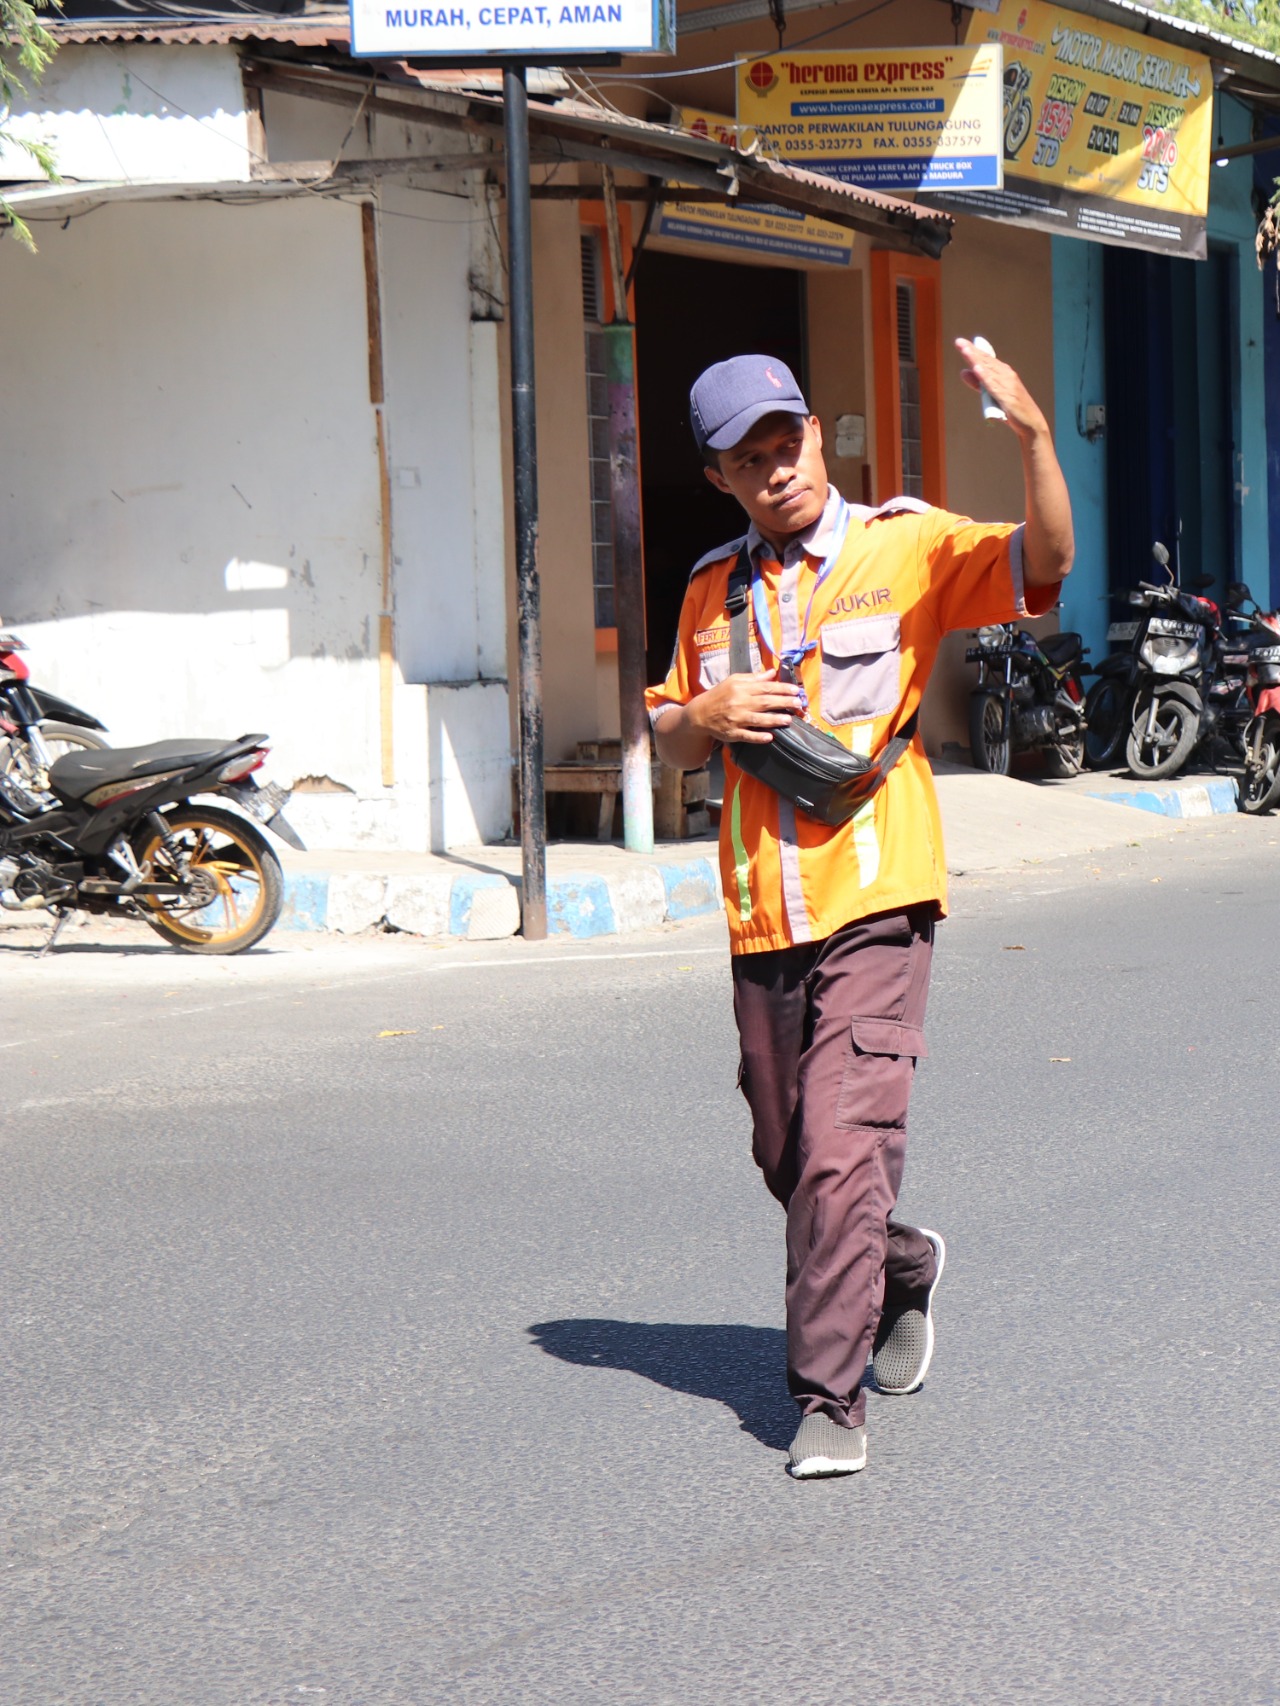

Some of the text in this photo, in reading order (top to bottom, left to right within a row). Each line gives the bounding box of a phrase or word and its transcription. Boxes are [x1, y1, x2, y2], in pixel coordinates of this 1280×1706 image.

[386, 4, 622, 30] MURAH, CEPAT, AMAN
[1051, 22, 1103, 72] MOTOR
[1100, 40, 1142, 84] MASUK
[1139, 53, 1200, 99] SEKOLAH
[1045, 74, 1086, 105] DISKON
[799, 99, 936, 114] www.heronaexpress.co.id
[1143, 102, 1186, 132] DISKON
[755, 119, 982, 135] KANTOR PERWAKILAN TULUNGAGUNG
[1035, 100, 1074, 142] 15%
[785, 137, 863, 150] 0355-323773
[873, 137, 899, 148] FAX.
[1032, 136, 1061, 168] STD
[1088, 128, 1118, 150] 2024
[851, 173, 876, 181] PULAU
[929, 171, 964, 179] MADURA
[878, 164, 906, 172] KERETA
[930, 162, 955, 170] TRUCK
[956, 162, 973, 170] BOX
[1137, 163, 1169, 193] STS
[828, 587, 893, 616] JUKIR
